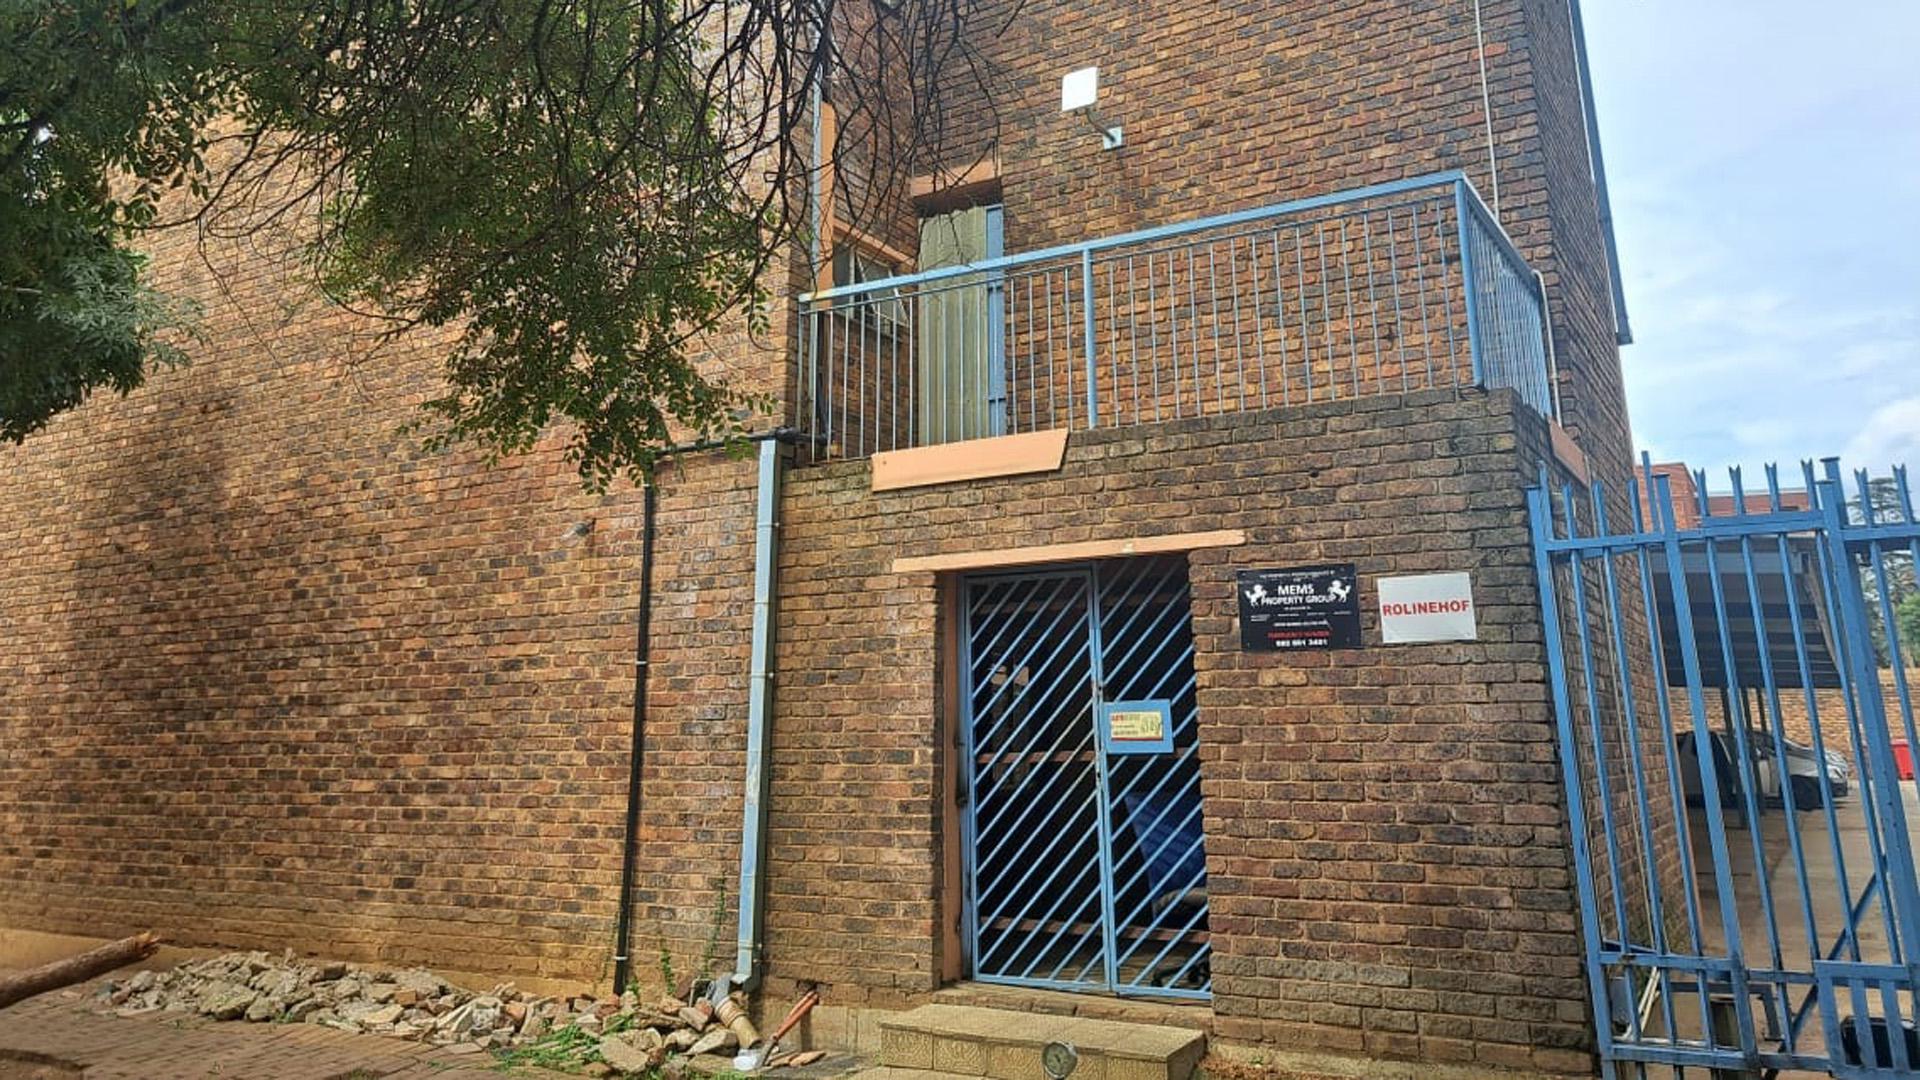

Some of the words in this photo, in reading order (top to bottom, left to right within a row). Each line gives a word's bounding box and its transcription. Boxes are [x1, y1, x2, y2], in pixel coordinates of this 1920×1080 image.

[1277, 583, 1315, 596] MEMS
[1261, 595, 1303, 606] PROPERTY
[1305, 593, 1337, 604] GROUP
[1382, 600, 1470, 616] ROLINEHOF
